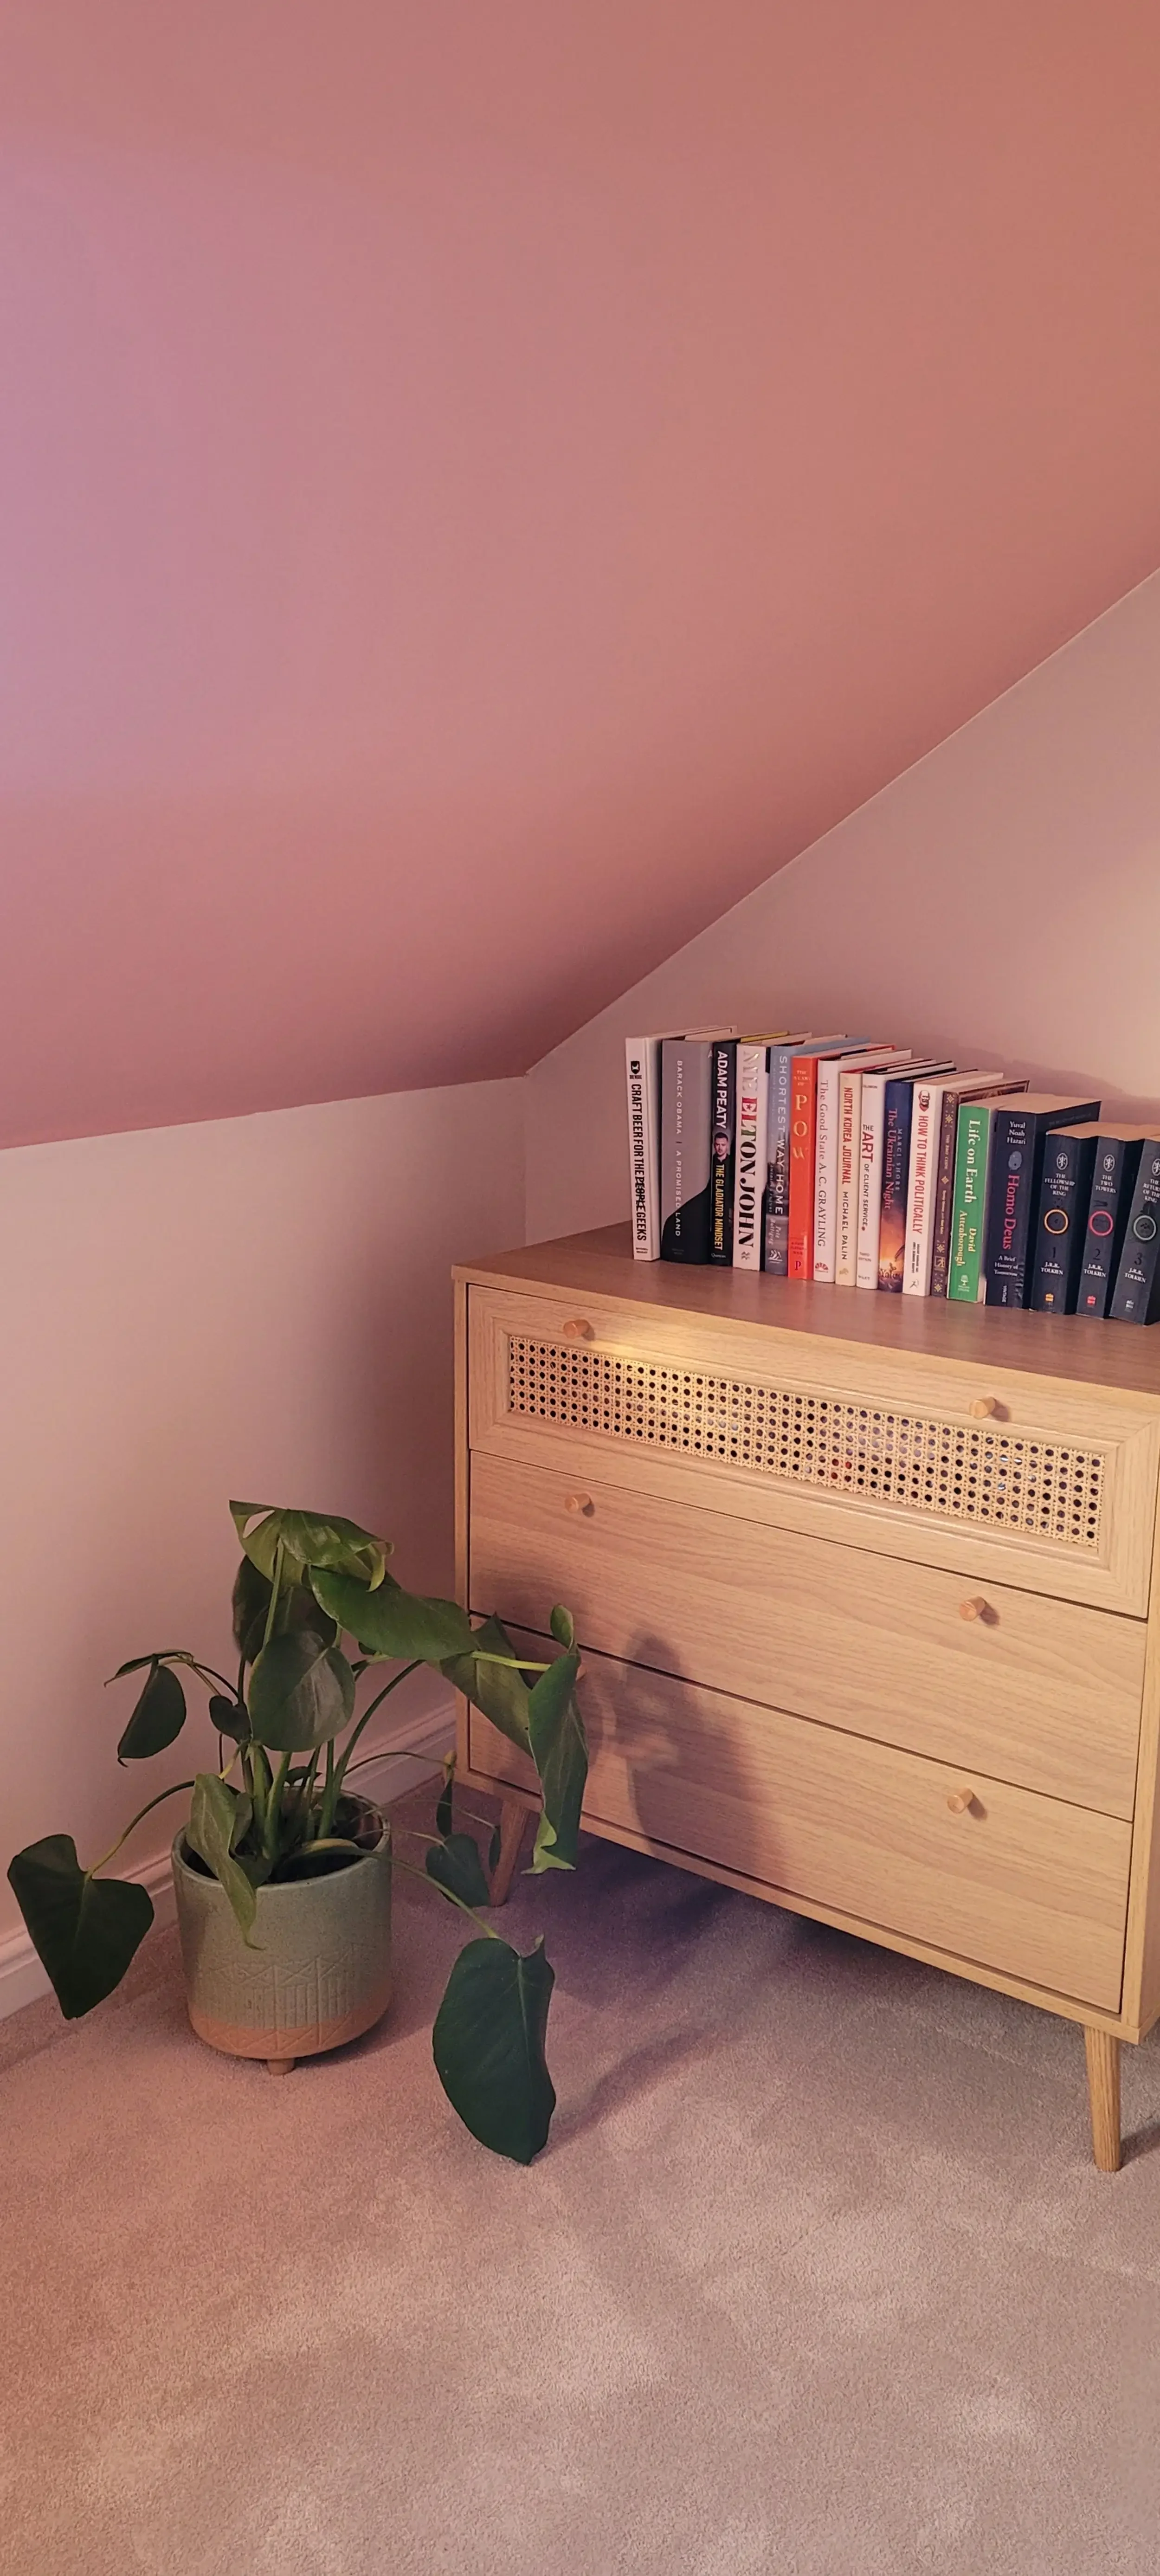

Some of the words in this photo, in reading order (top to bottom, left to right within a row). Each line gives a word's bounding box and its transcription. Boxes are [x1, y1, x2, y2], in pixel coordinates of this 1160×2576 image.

[717, 1051, 728, 1087] ADAM
[632, 1084, 642, 1113] CRAFT
[778, 1055, 787, 1132] SHORTEST
[844, 1087, 853, 1114] NORTH
[716, 1090, 727, 1129] PEATY
[888, 1108, 898, 1126] The
[632, 1115, 643, 1137] BEER
[740, 1097, 757, 1176] ELTON
[843, 1117, 852, 1143] KOREA
[917, 1116, 928, 1136] HOW
[968, 1120, 981, 1145] Life
[633, 1139, 644, 1156] FOR
[776, 1139, 785, 1167] WAY
[862, 1131, 874, 1163] ART
[886, 1130, 896, 1177] Ukrainian
[917, 1139, 927, 1149] TO
[967, 1148, 975, 1164] on
[634, 1158, 644, 1175] THE
[715, 1164, 724, 1177] THE
[819, 1162, 827, 1173] A.
[842, 1146, 852, 1184] JOURNAL
[864, 1163, 869, 1173] OF
[915, 1152, 927, 1178] THINK
[775, 1174, 784, 1214] HOME
[819, 1176, 827, 1186] C.
[964, 1168, 978, 1203] Earth
[1095, 1185, 1116, 1194] TOWERS
[715, 1180, 724, 1217] GLADIATOR
[883, 1181, 894, 1209] Night
[912, 1180, 925, 1234] POLITICALLY
[1005, 1175, 1020, 1215] Homo
[739, 1177, 755, 1248] JOHN
[818, 1190, 826, 1247] GRAYLING
[636, 1212, 646, 1241] GEEKS
[714, 1220, 723, 1251] MINDSET
[954, 1210, 967, 1266] Attenborough
[968, 1228, 977, 1252] David
[1003, 1218, 1016, 1250] Deus
[1052, 1247, 1056, 1258] 1
[1093, 1248, 1101, 1260] 2
[1134, 1252, 1143, 1265] 3
[1084, 1269, 1107, 1278] TOLKIEN
[1124, 1272, 1147, 1283] TOLKIEN
